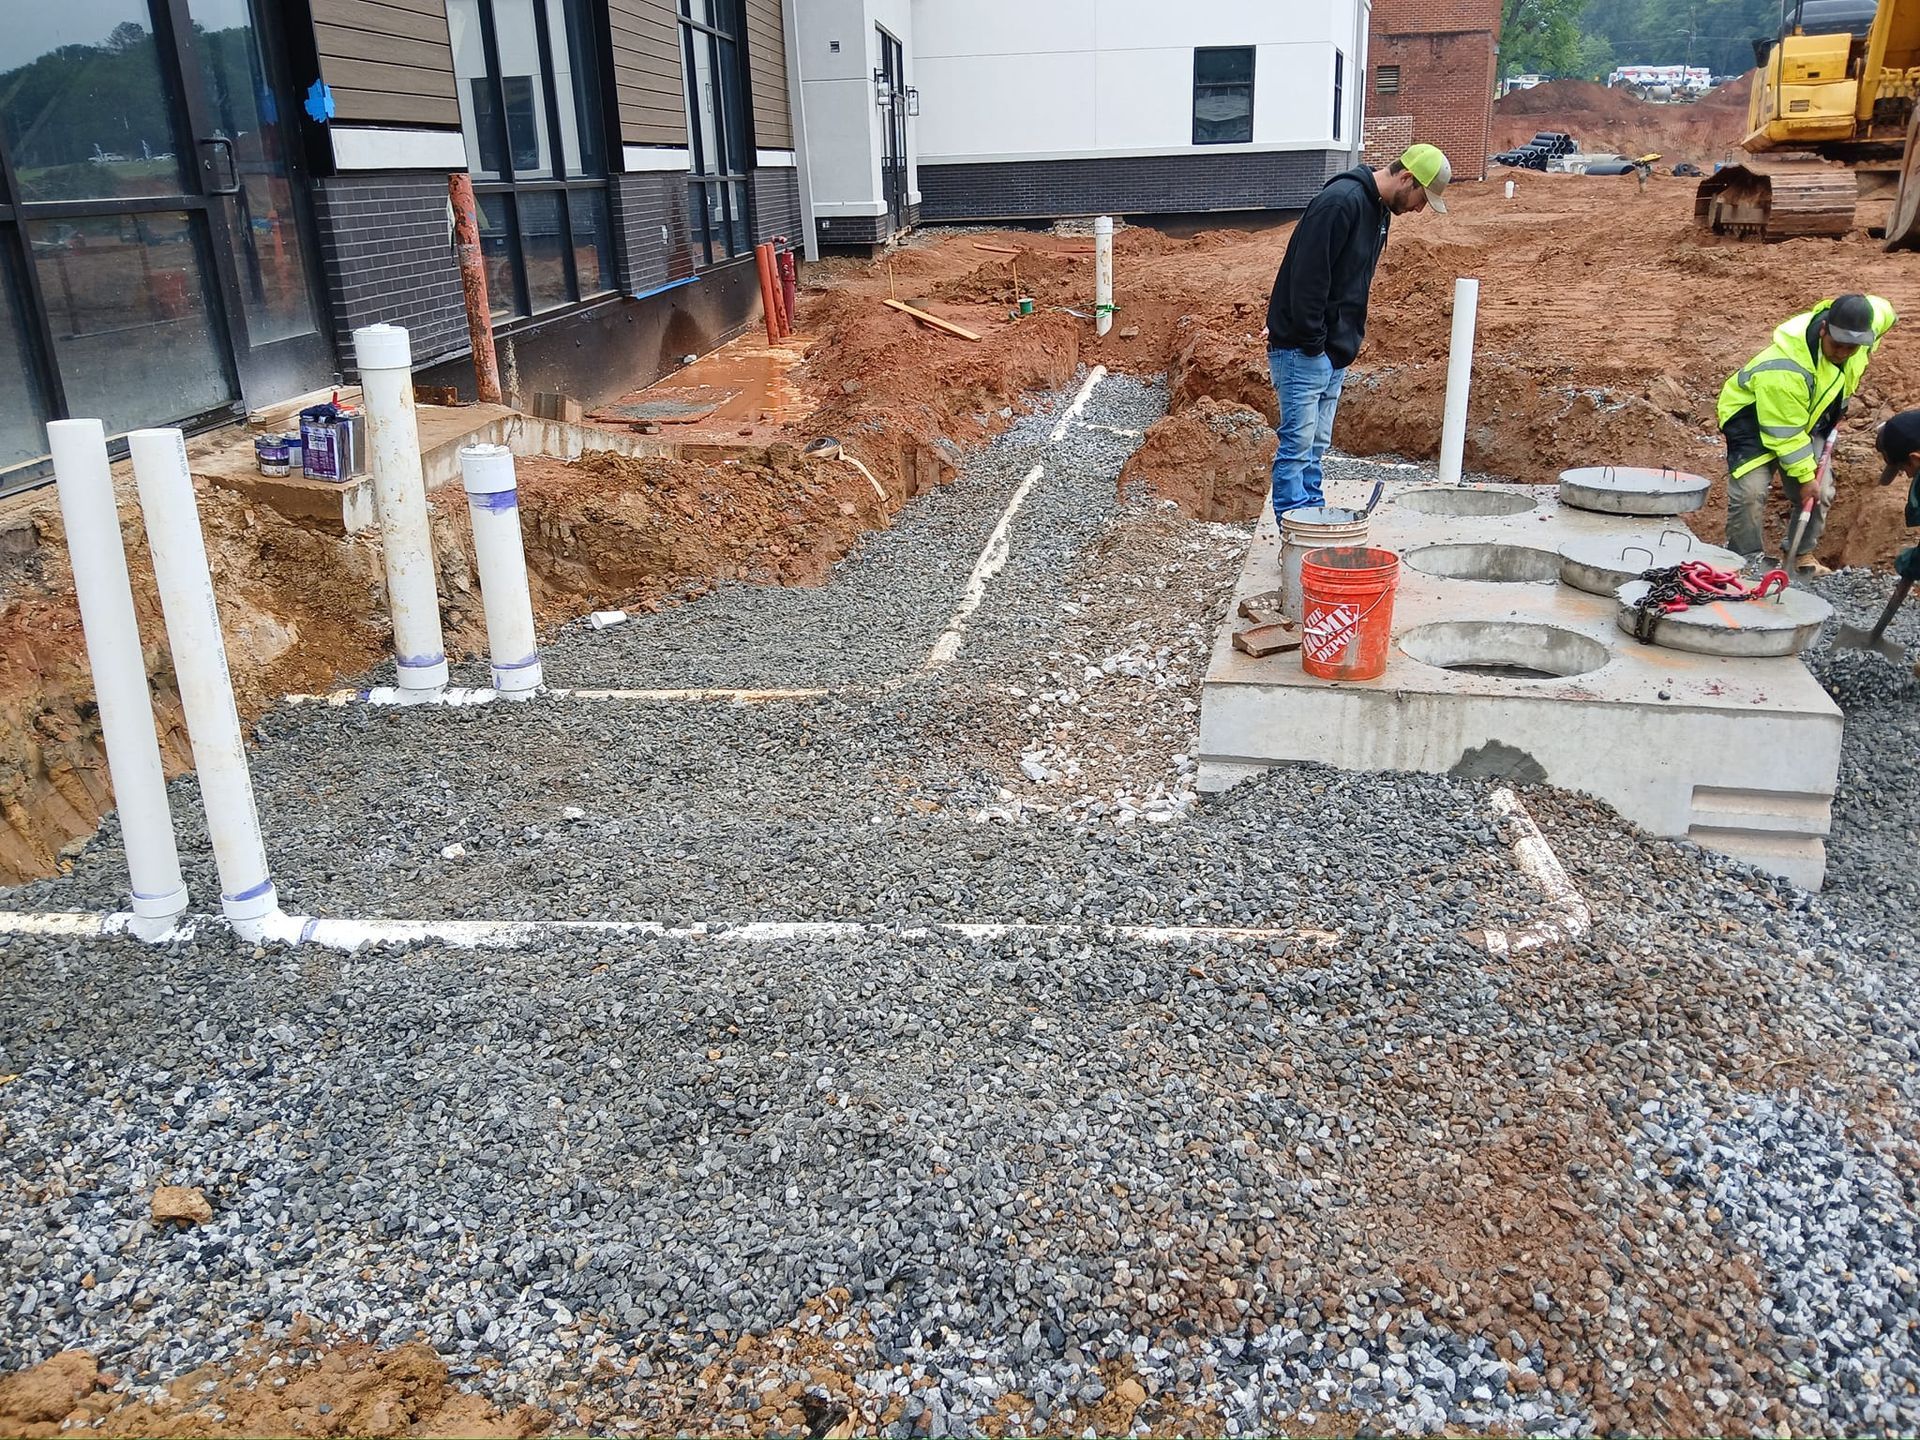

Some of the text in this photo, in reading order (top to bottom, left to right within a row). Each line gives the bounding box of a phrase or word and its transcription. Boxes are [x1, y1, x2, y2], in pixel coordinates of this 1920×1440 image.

[1304, 606, 1357, 654] HOME
[1305, 607, 1325, 627] THE
[1316, 626, 1355, 662] DEPOT
